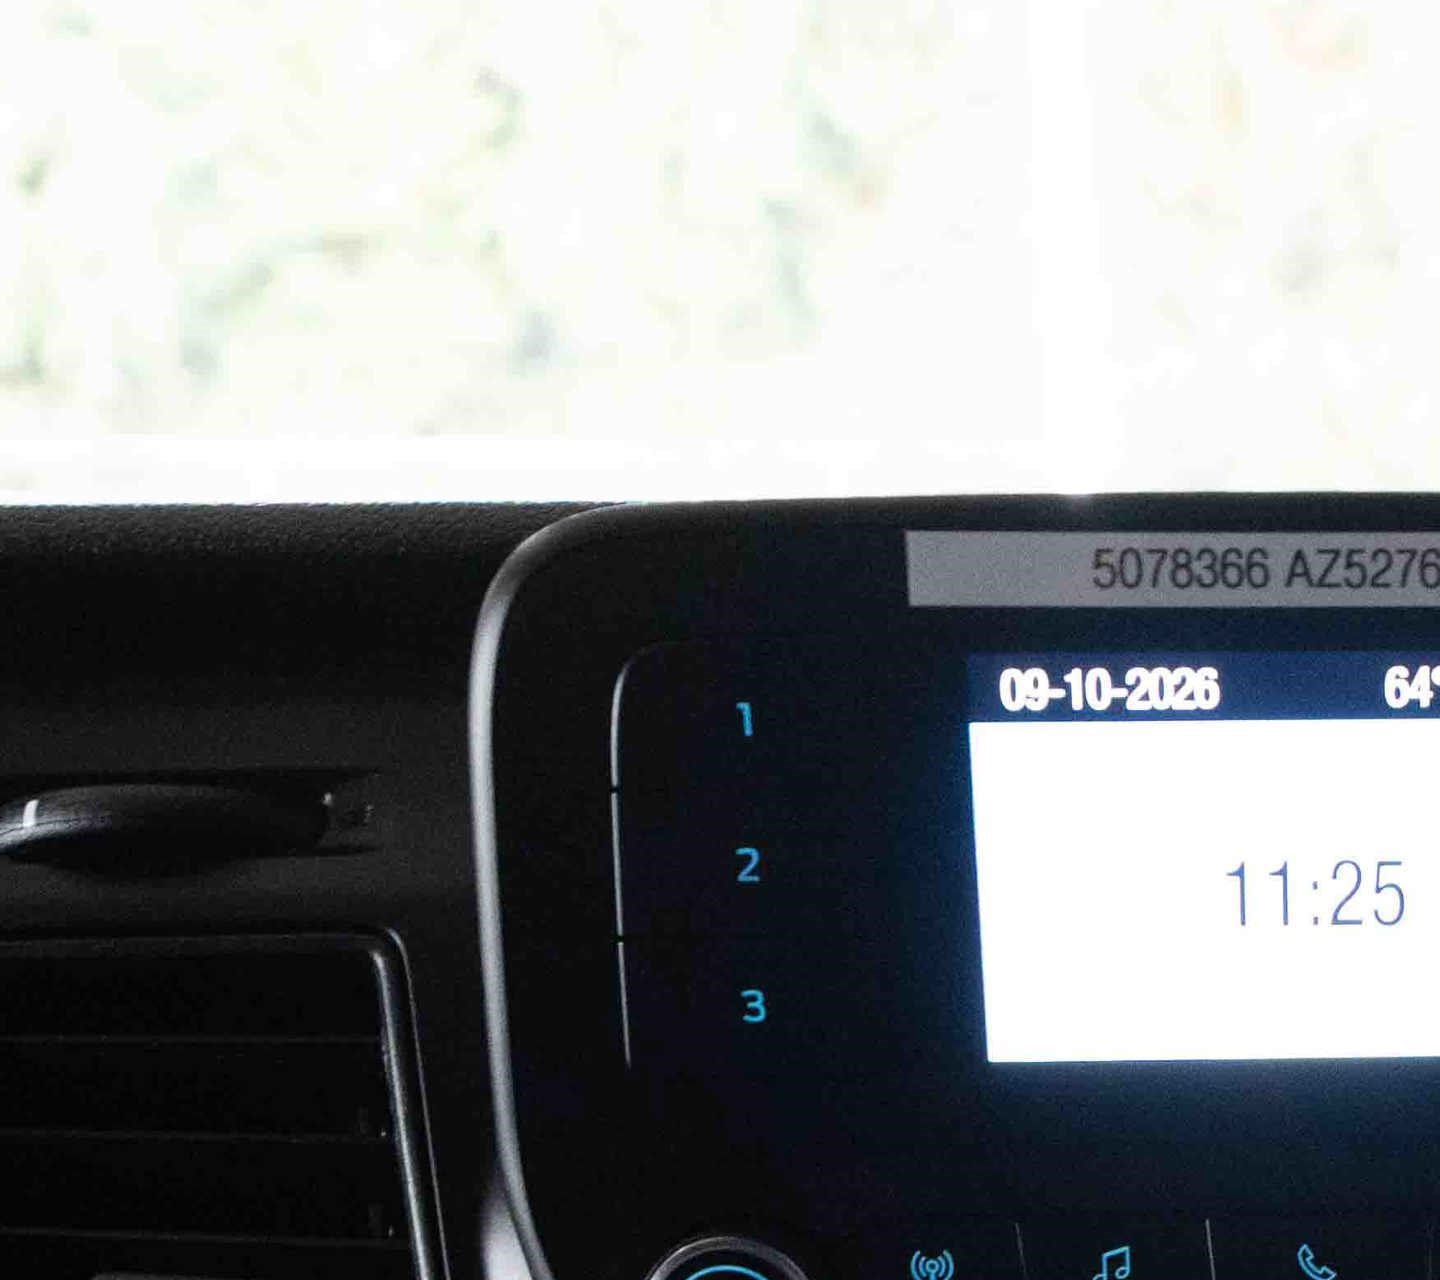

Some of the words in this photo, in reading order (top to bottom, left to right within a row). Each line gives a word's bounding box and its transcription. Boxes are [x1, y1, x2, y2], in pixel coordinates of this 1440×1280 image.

[1094, 548, 1270, 589] 5078366
[1000, 667, 1220, 711] 09-10-2026
[737, 703, 752, 736] 1
[736, 848, 759, 881] 2
[1228, 861, 1404, 925] 11:25
[742, 990, 765, 1022] 3
